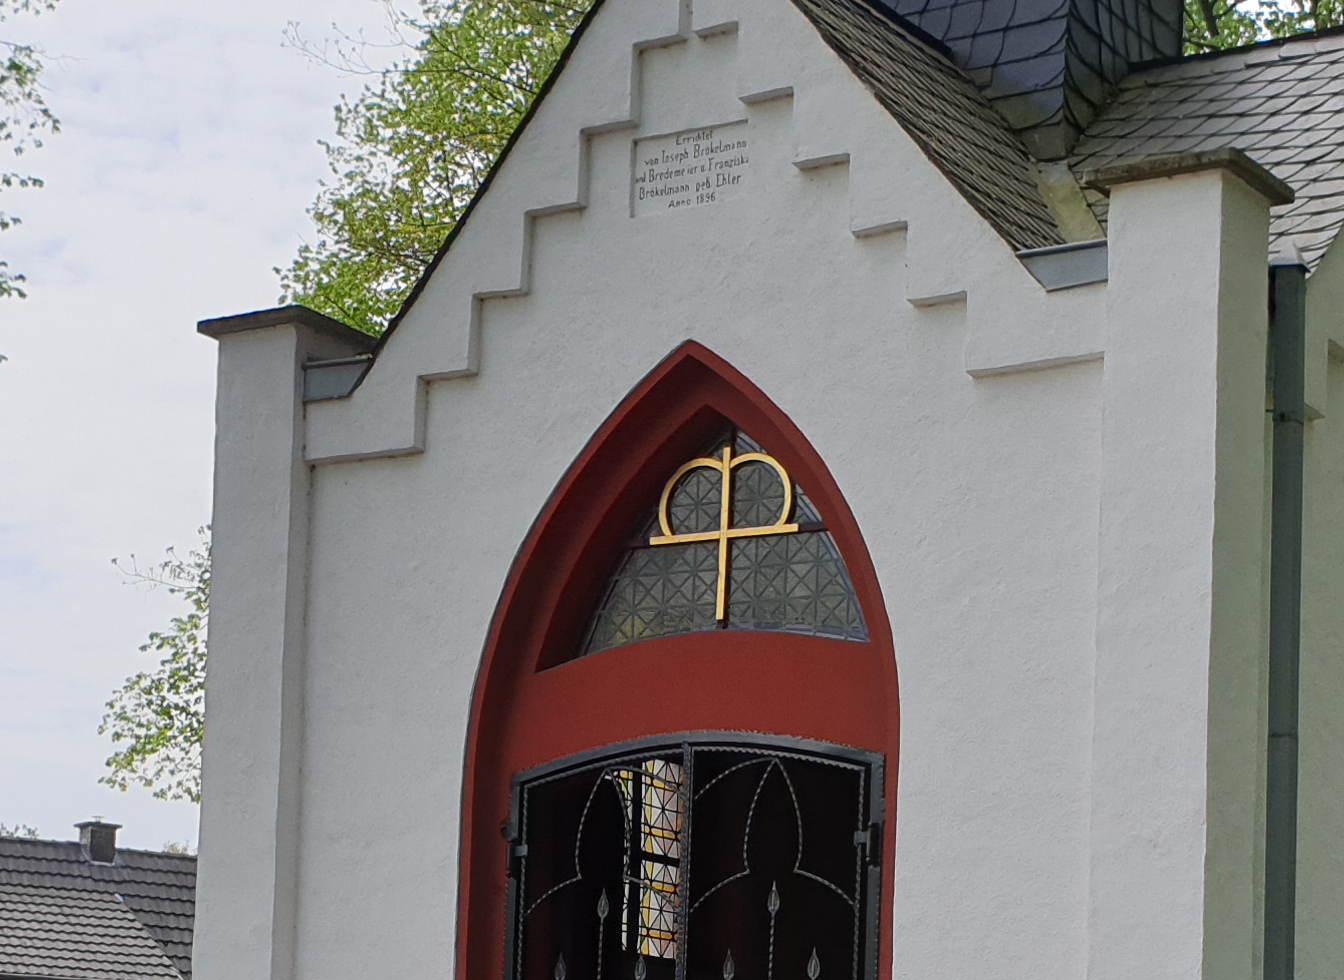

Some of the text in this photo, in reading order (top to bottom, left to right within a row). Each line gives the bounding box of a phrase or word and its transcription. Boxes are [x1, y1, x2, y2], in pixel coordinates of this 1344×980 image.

[675, 130, 714, 146] Errichtet
[667, 191, 716, 209] Anno 1896
